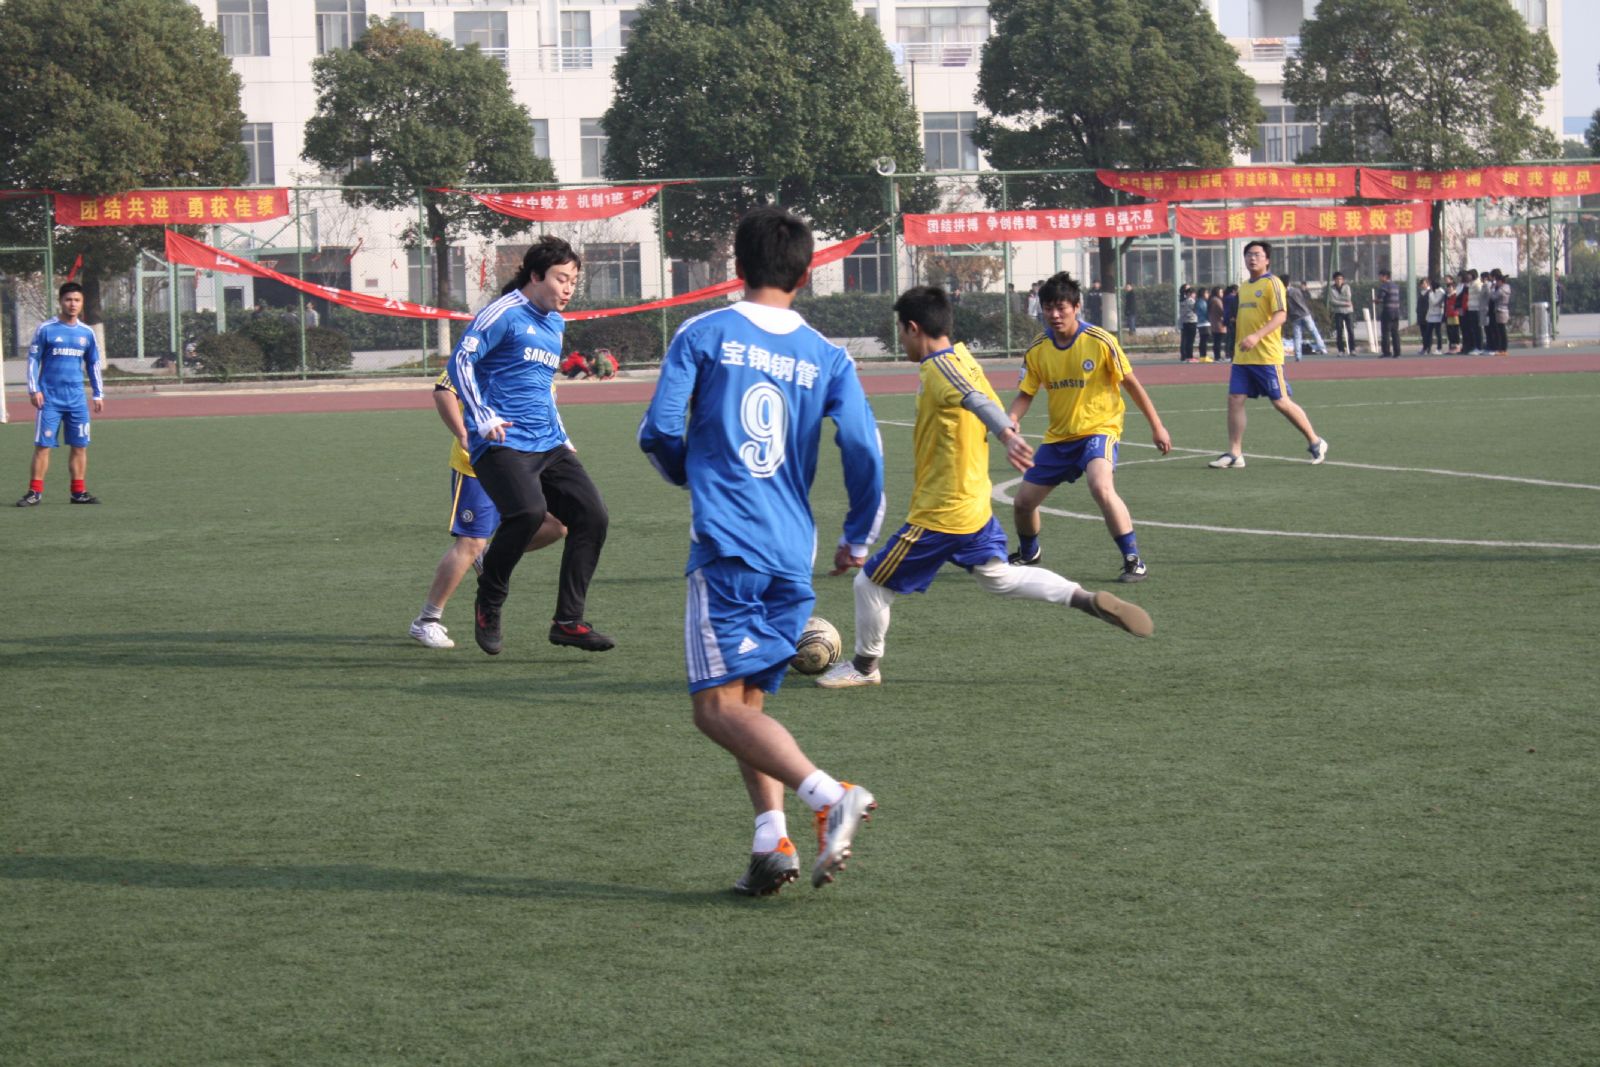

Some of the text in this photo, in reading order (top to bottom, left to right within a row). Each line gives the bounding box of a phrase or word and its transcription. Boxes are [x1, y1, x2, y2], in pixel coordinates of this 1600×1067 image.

[79, 195, 275, 221] 团结共进 勇获佳绩
[1104, 208, 1155, 226] 自强不息
[1202, 209, 1415, 235] 光辉岁月 唯我数控
[720, 340, 820, 390] 宝钢钢管
[739, 381, 788, 478] 9
